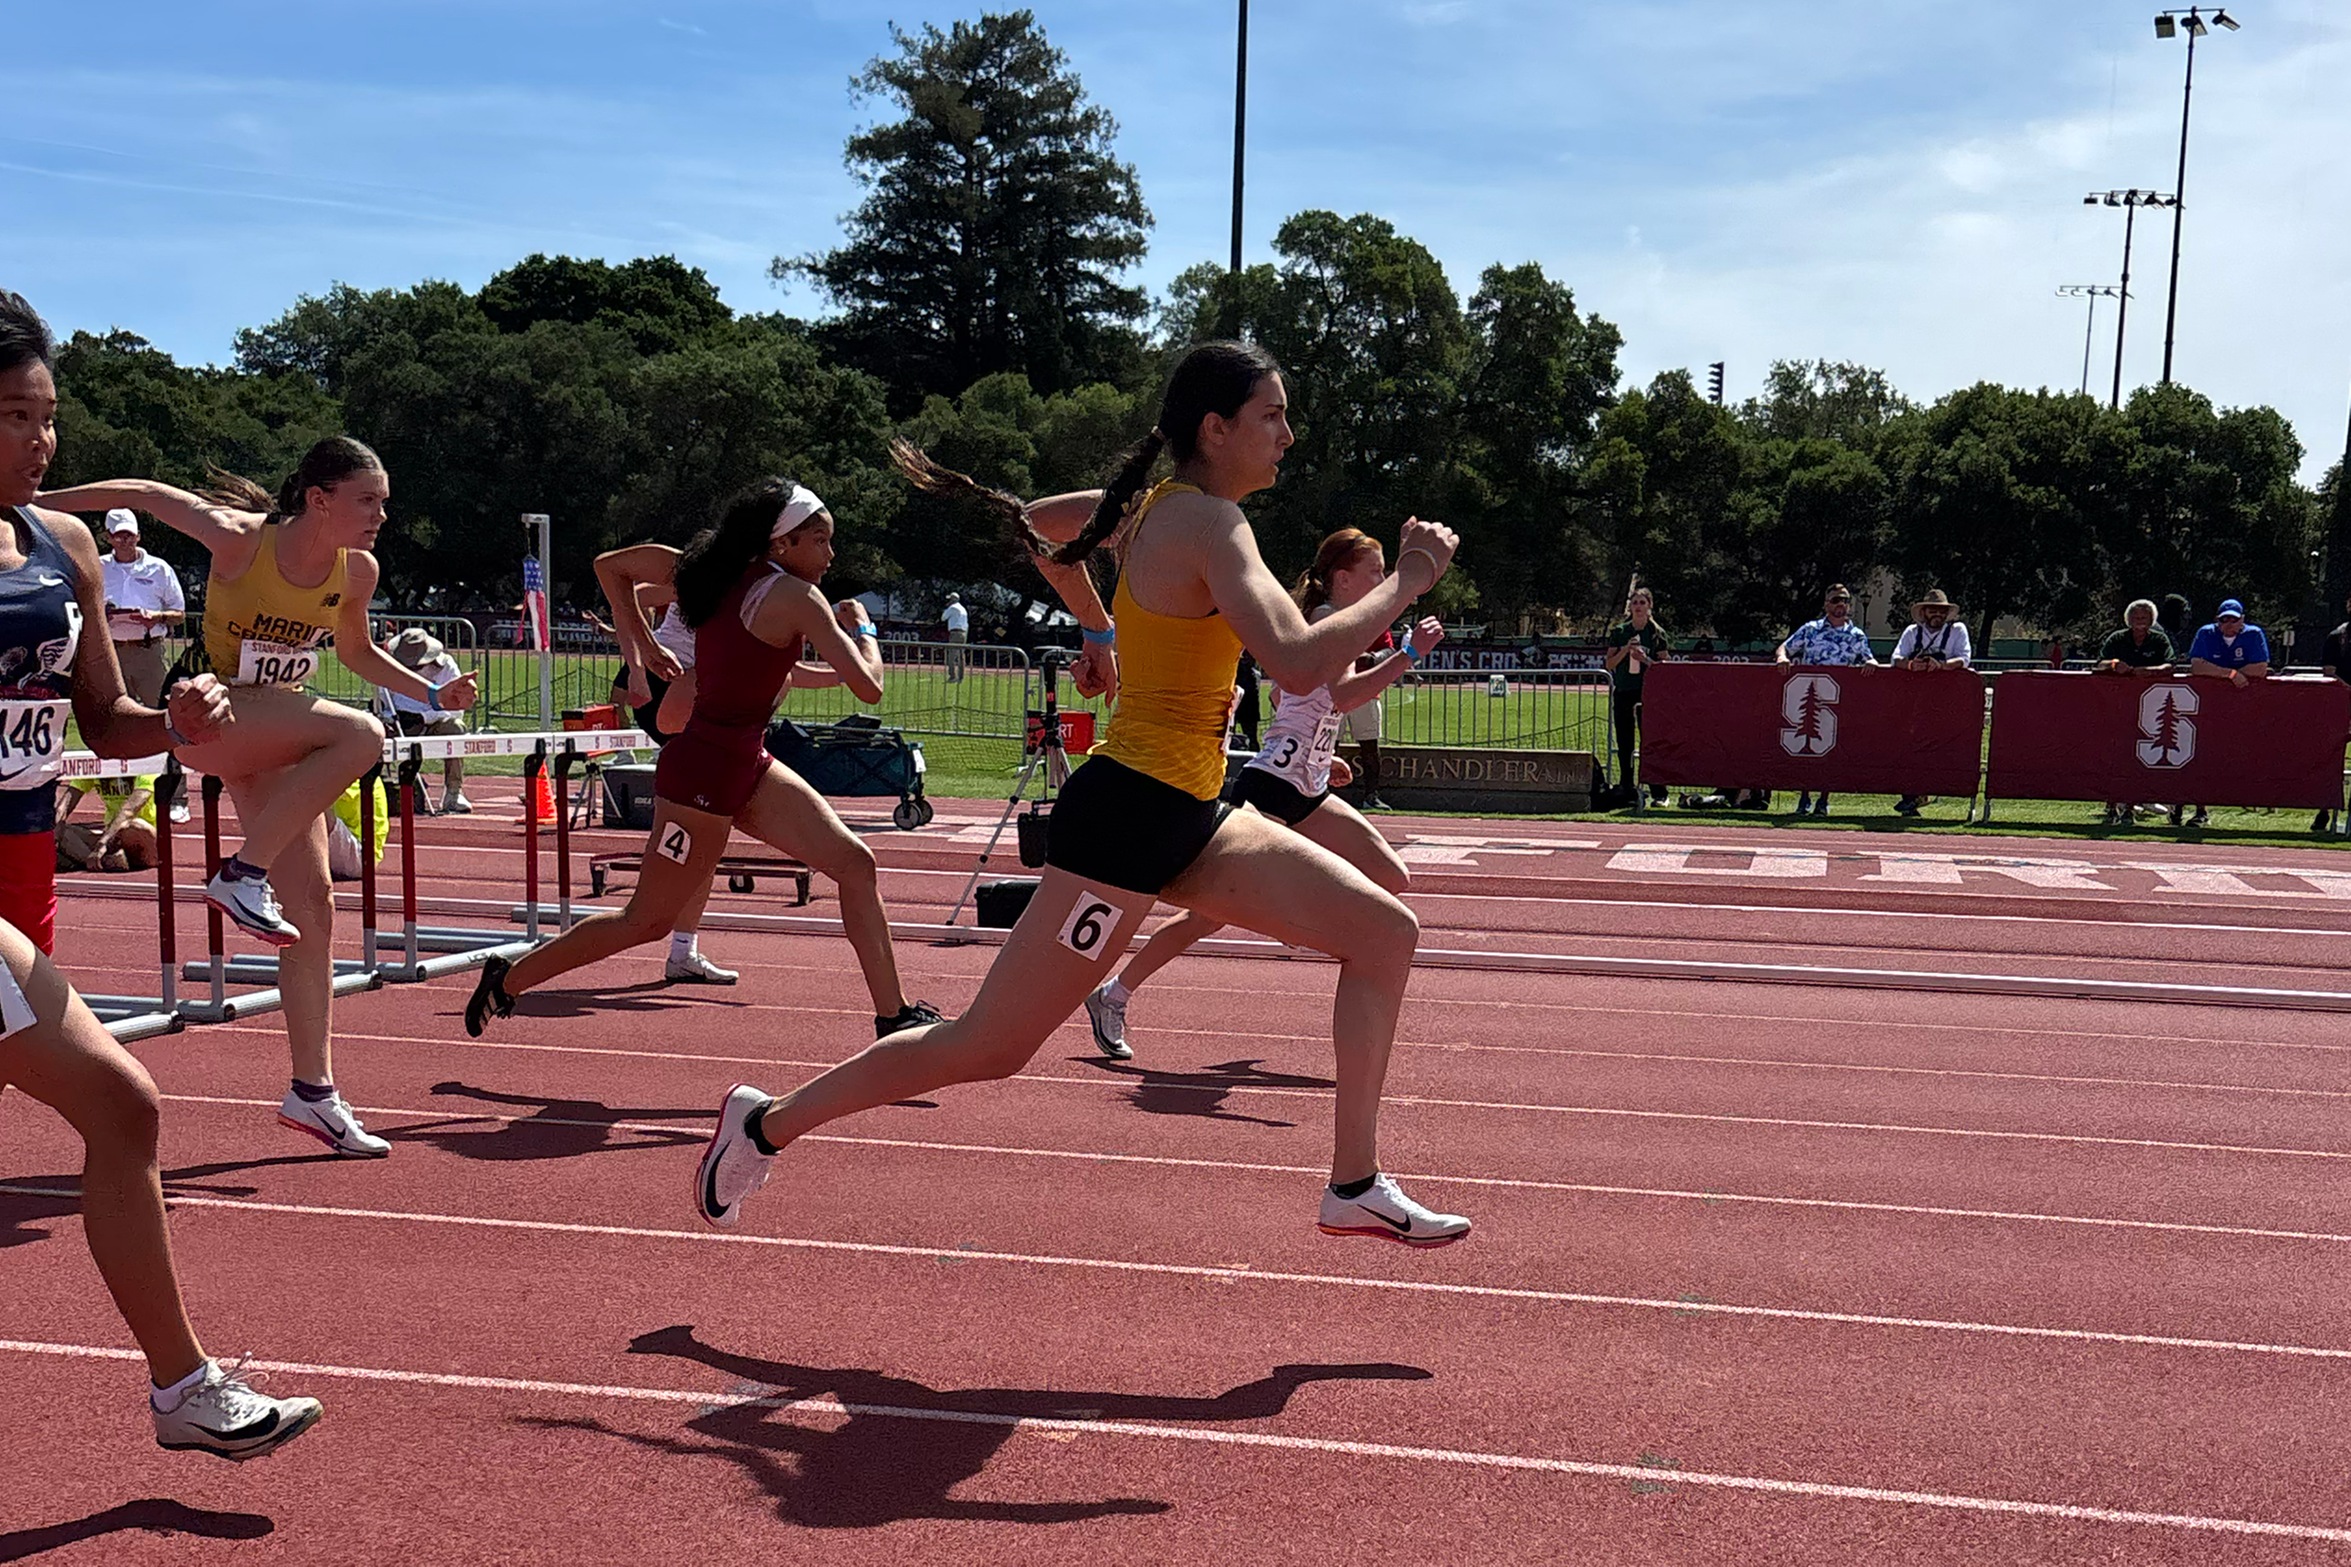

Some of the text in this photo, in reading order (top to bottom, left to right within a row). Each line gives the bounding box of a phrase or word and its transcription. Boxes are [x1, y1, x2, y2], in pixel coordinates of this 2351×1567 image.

[254, 656, 312, 685] 1942
[1478, 651, 1520, 669] CRO
[1780, 673, 1840, 757] S
[2136, 683, 2199, 769] S
[60, 757, 101, 776] ANFORD
[1273, 738, 1298, 768] 3
[664, 828, 685, 859] 4
[1071, 903, 1112, 951] 6
